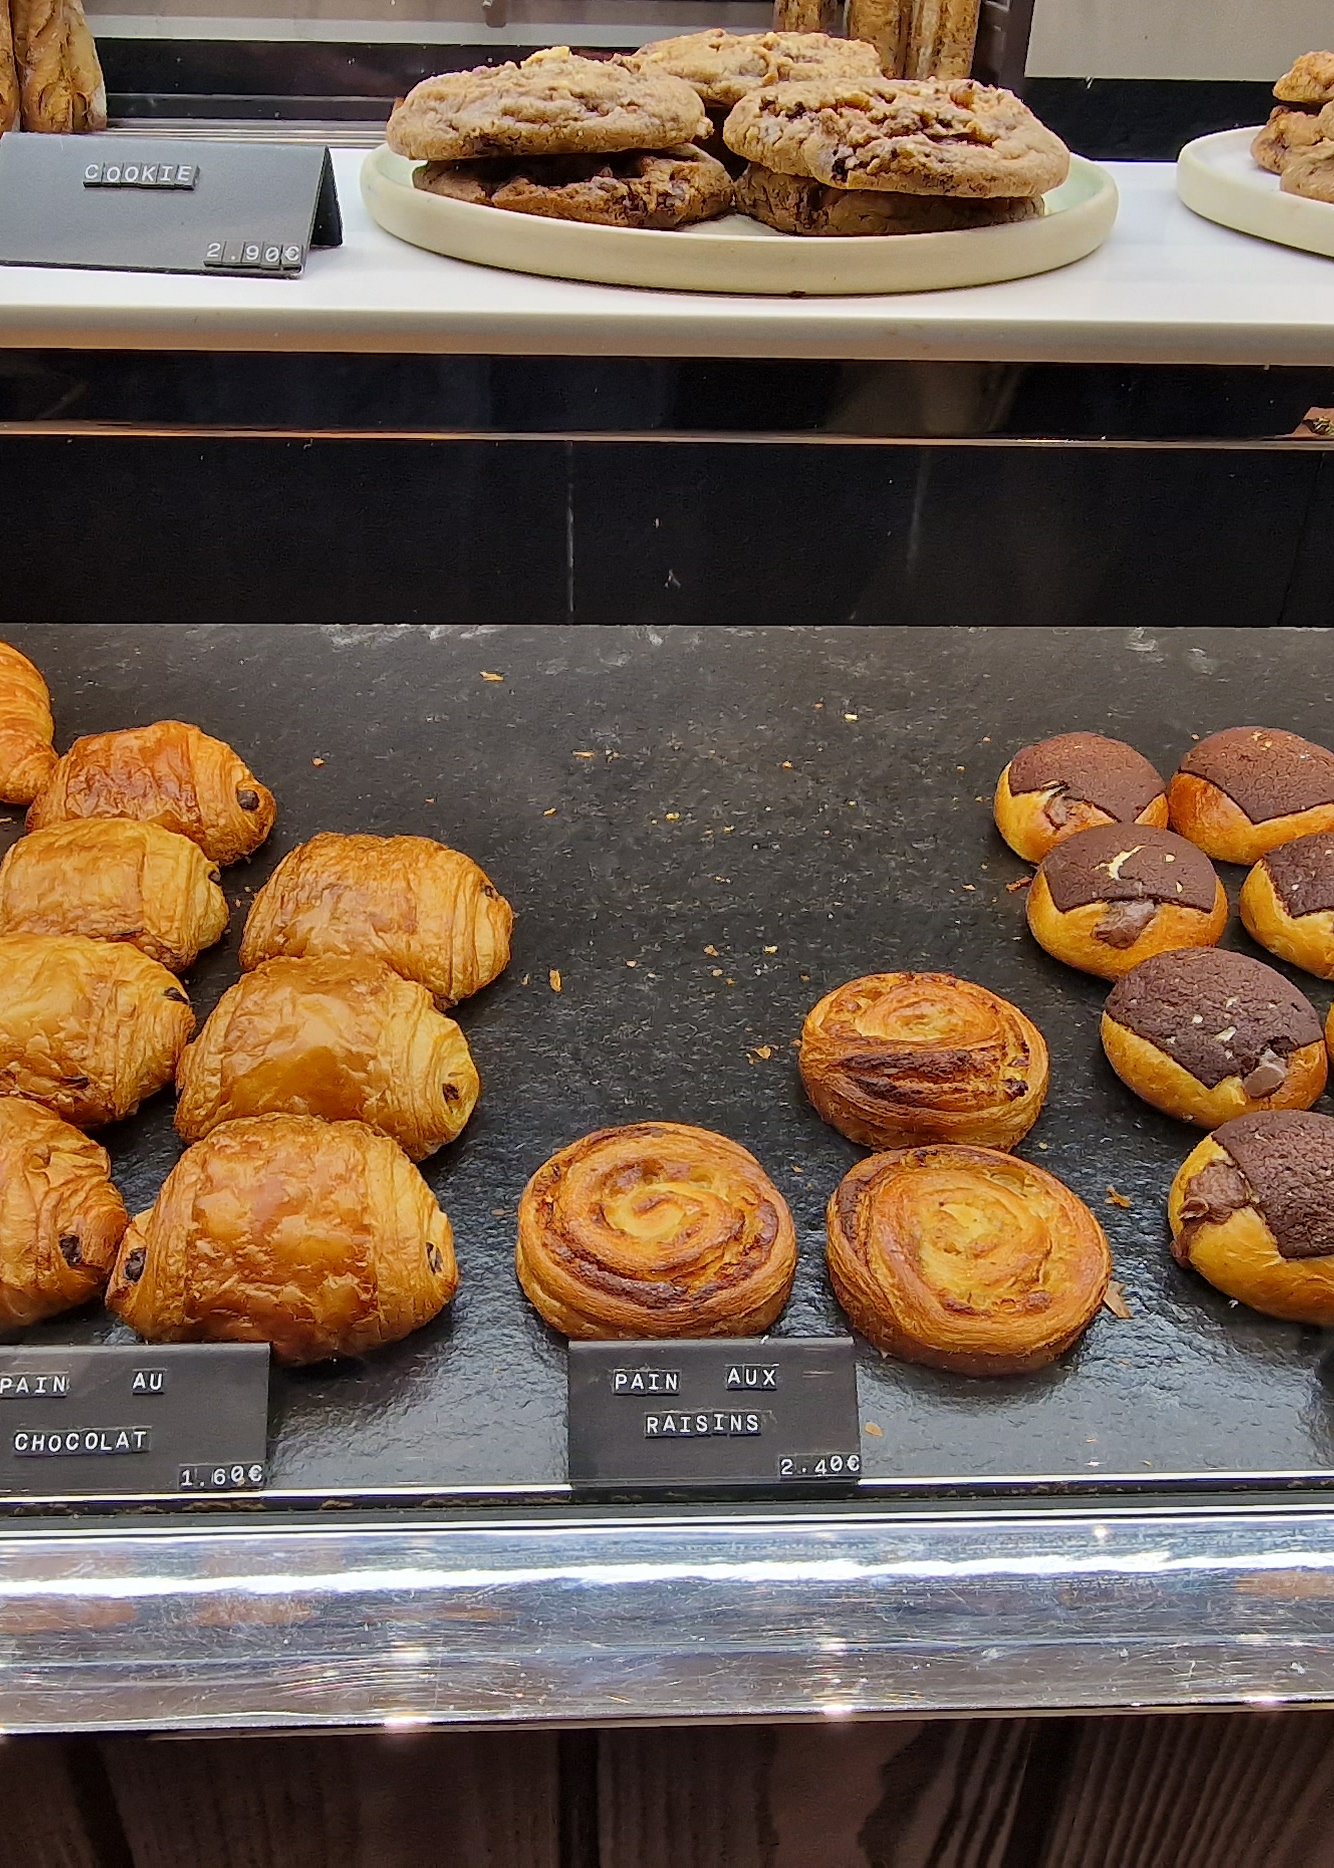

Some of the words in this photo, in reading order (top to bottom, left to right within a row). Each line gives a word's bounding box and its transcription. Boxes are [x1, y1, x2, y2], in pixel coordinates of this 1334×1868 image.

[84, 163, 193, 183] COOKIE
[207, 242, 300, 262] 2.90€
[132, 1371, 164, 1391] AU
[614, 1373, 678, 1391] PAIN
[726, 1367, 776, 1387] AUX
[646, 1413, 759, 1434] RAISINS
[14, 1431, 148, 1452] CHOCOLAT
[780, 1454, 860, 1475] 2.40€
[180, 1464, 263, 1487] 1.60€
